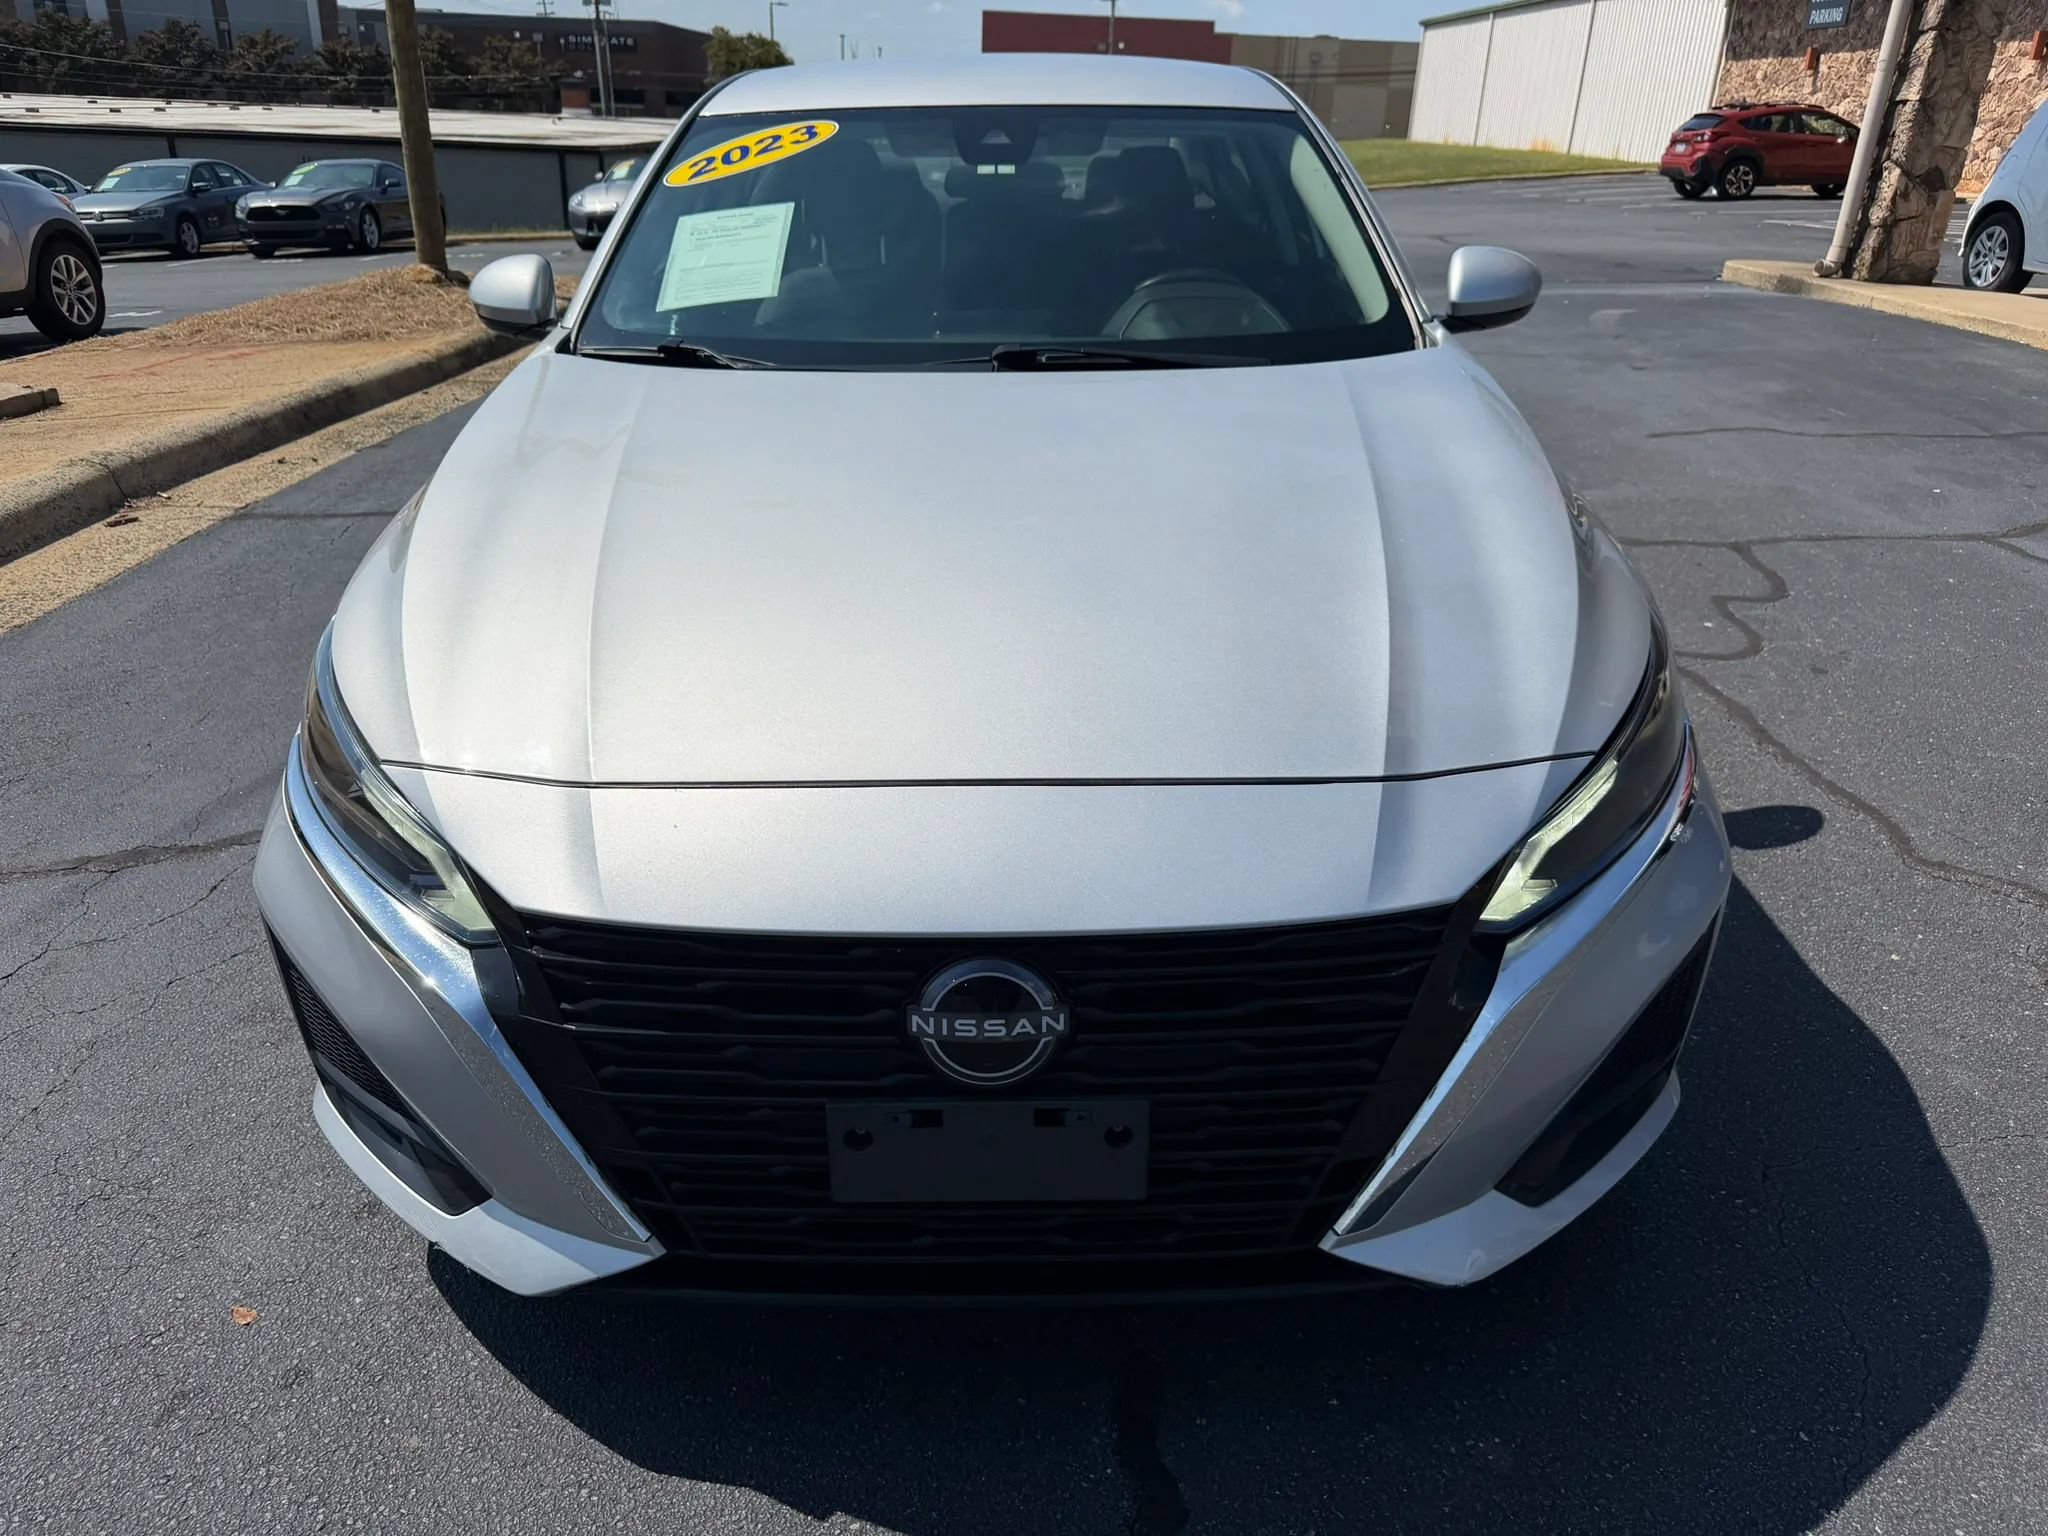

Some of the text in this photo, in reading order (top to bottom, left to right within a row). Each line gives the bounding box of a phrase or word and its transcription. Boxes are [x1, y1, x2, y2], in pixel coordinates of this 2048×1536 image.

[1809, 6, 1844, 25] PARKING
[687, 125, 821, 182] 2023
[911, 1012, 1066, 1037] NISSAN
